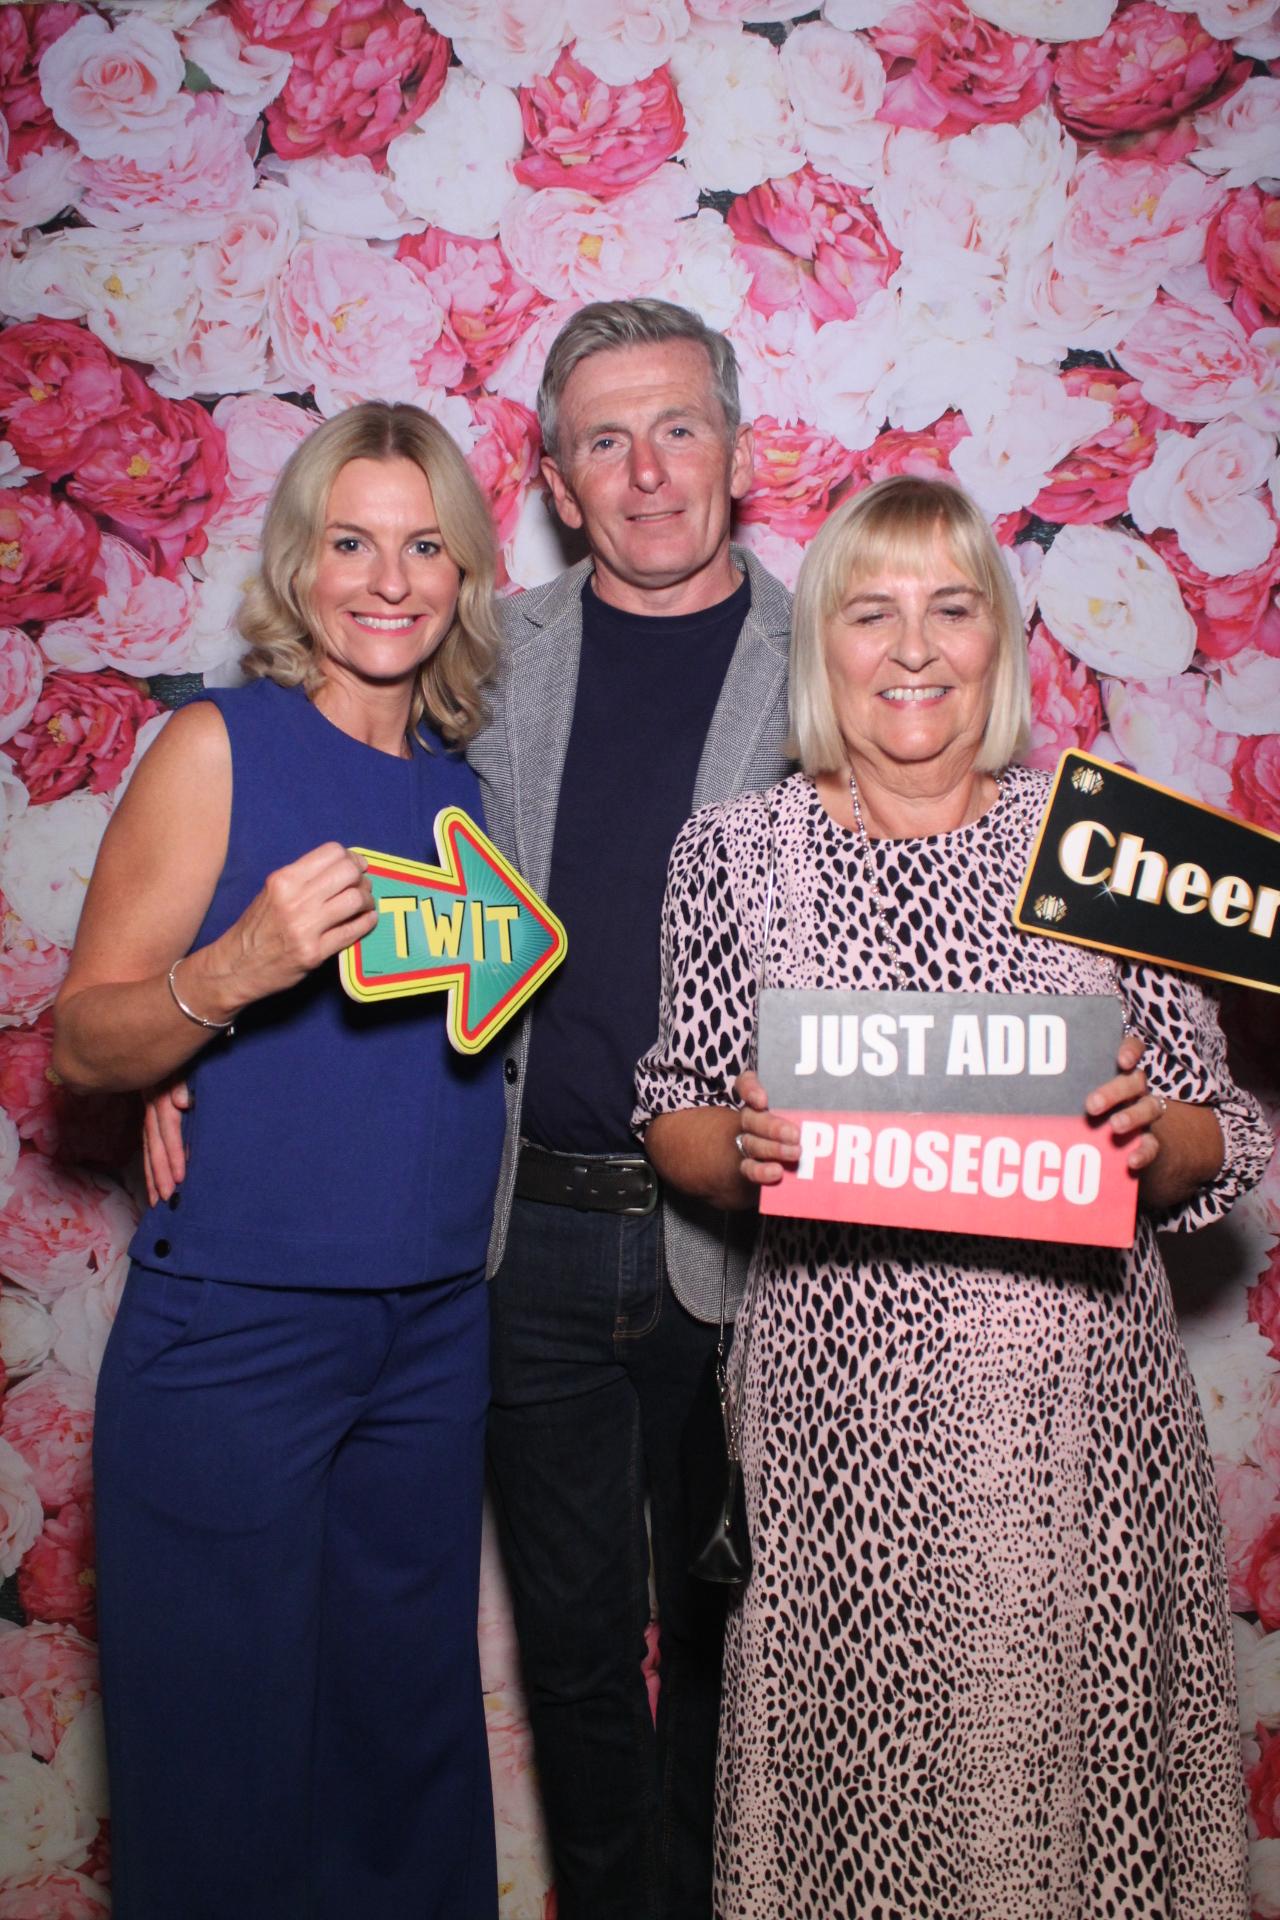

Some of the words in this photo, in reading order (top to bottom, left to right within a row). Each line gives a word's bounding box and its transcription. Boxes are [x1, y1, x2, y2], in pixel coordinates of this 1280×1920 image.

[1058, 820, 1280, 938] Cheer
[378, 896, 519, 965] TWIT
[794, 1014, 934, 1077] JUST
[946, 1014, 1067, 1076] ADD
[797, 1120, 1102, 1206] PROSECCO
